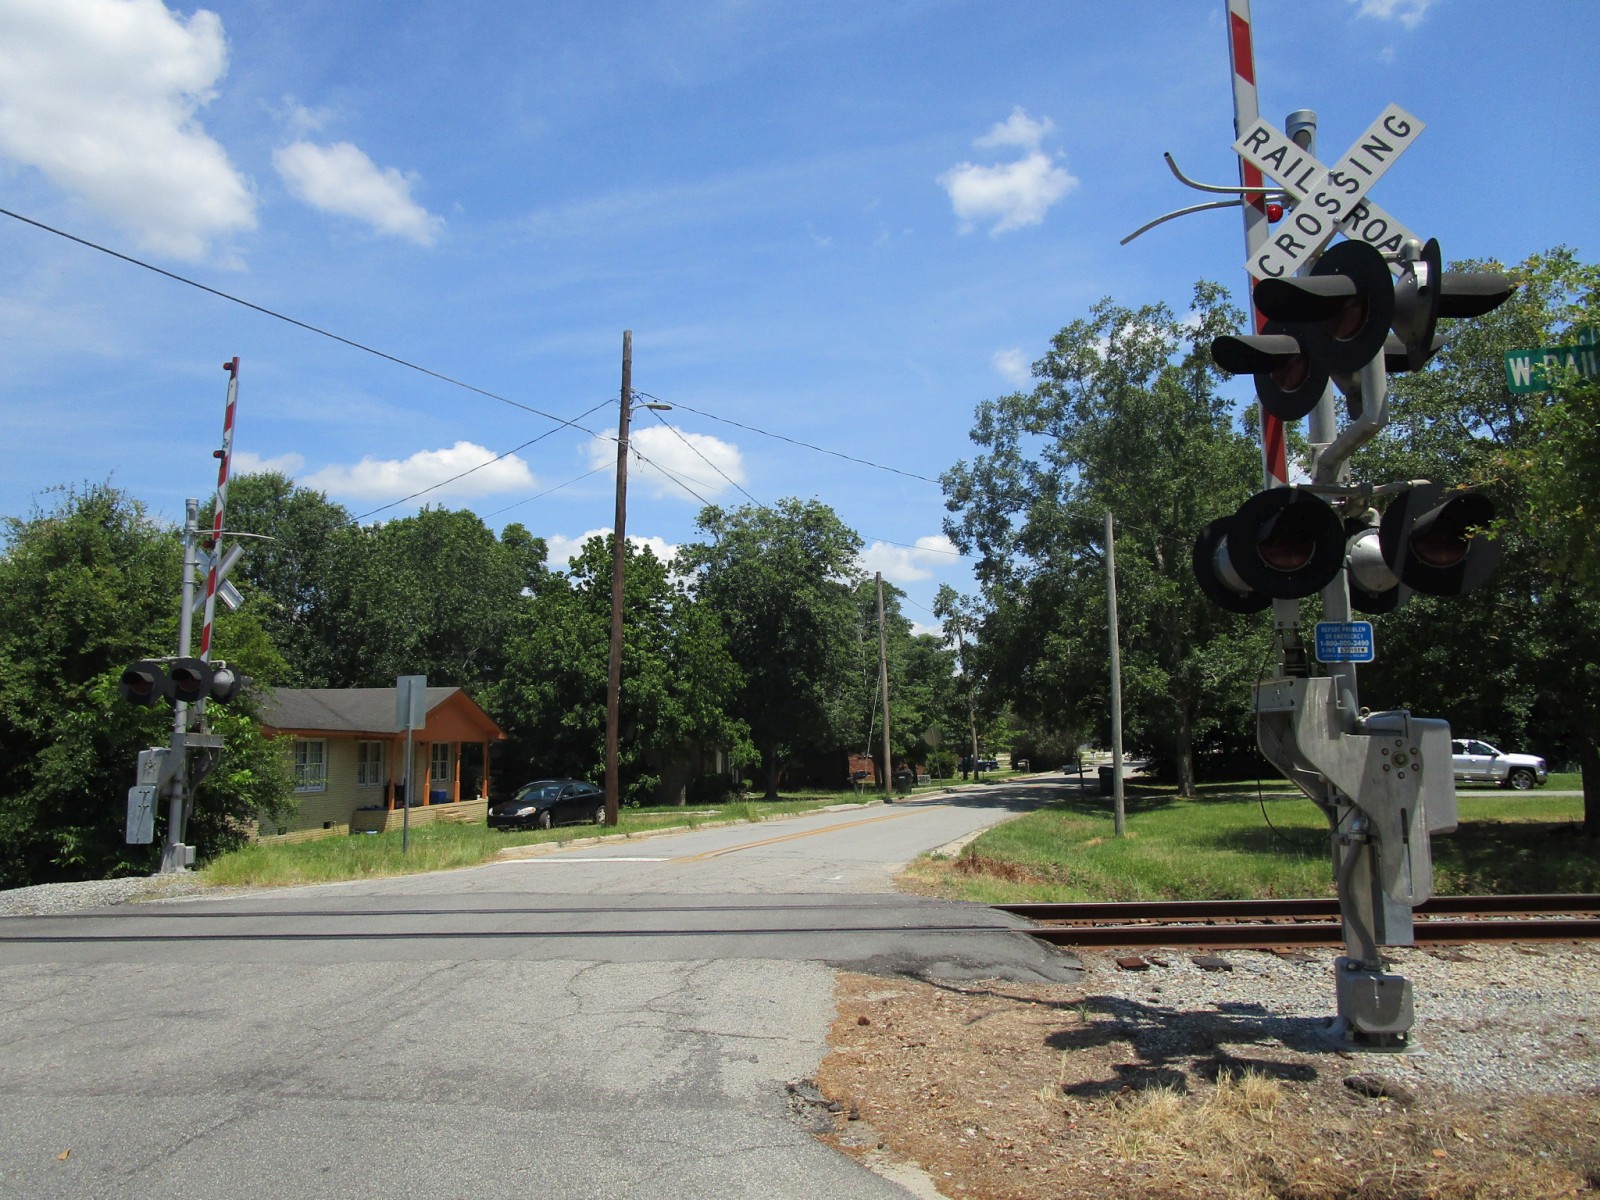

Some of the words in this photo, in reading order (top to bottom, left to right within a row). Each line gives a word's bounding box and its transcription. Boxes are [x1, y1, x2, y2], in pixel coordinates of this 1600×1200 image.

[1242, 126, 1315, 195] RAIL
[1341, 202, 1403, 252] ROA
[1258, 115, 1411, 278] CROSSING
[1508, 357, 1530, 387] W
